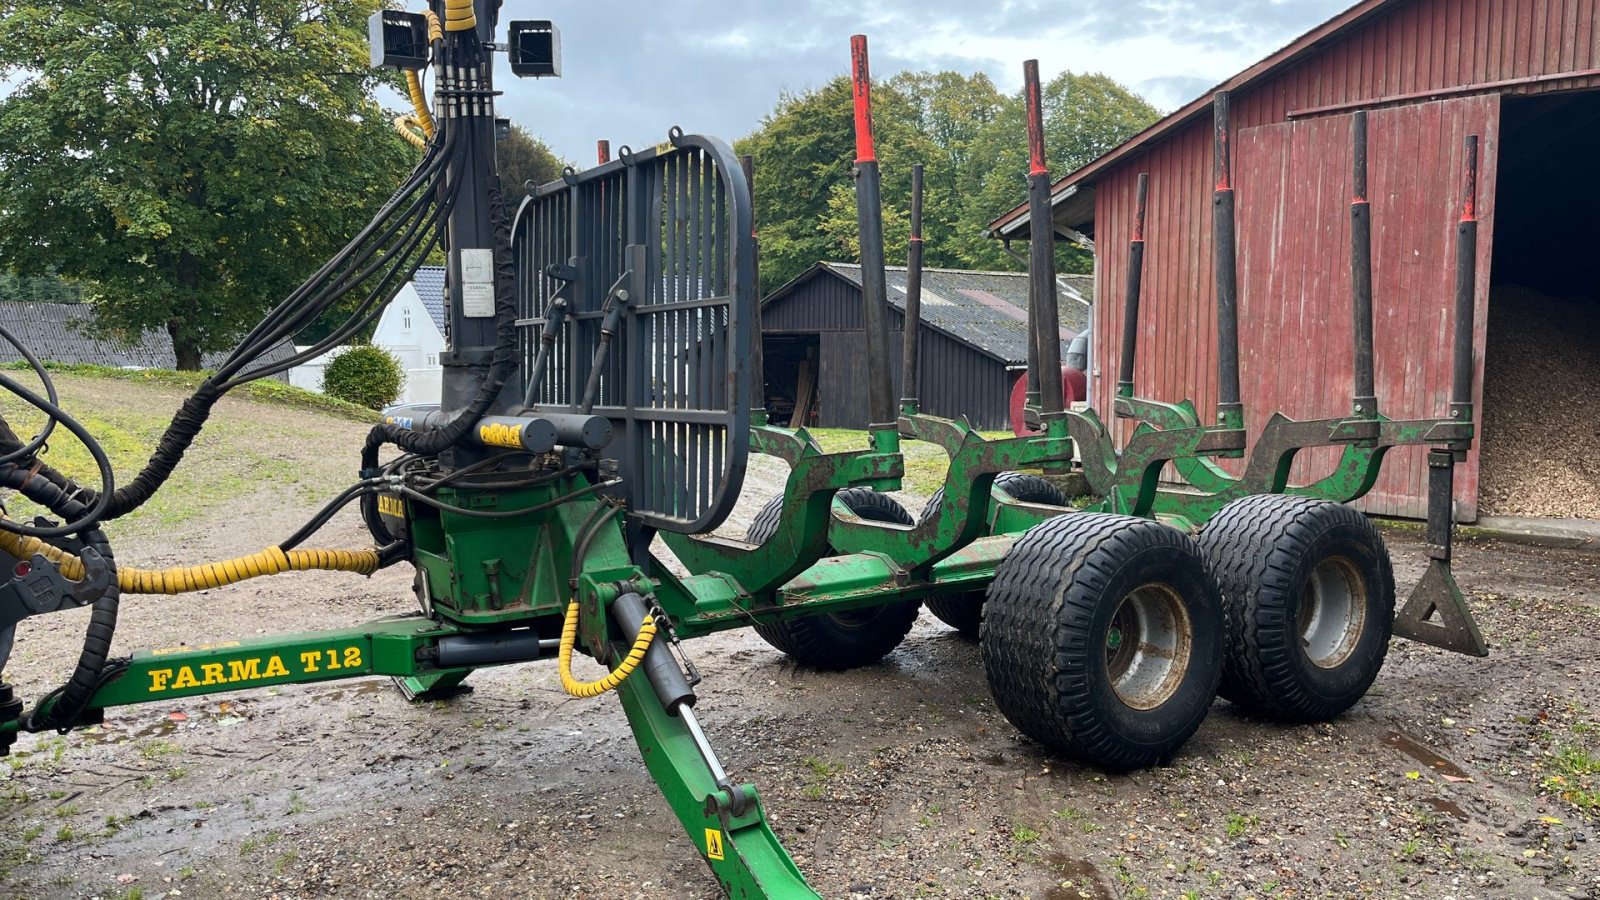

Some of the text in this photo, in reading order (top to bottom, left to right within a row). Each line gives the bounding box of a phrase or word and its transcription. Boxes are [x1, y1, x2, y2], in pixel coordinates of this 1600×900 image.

[377, 495, 405, 518] ARMA
[148, 647, 362, 692] FARMA T12
